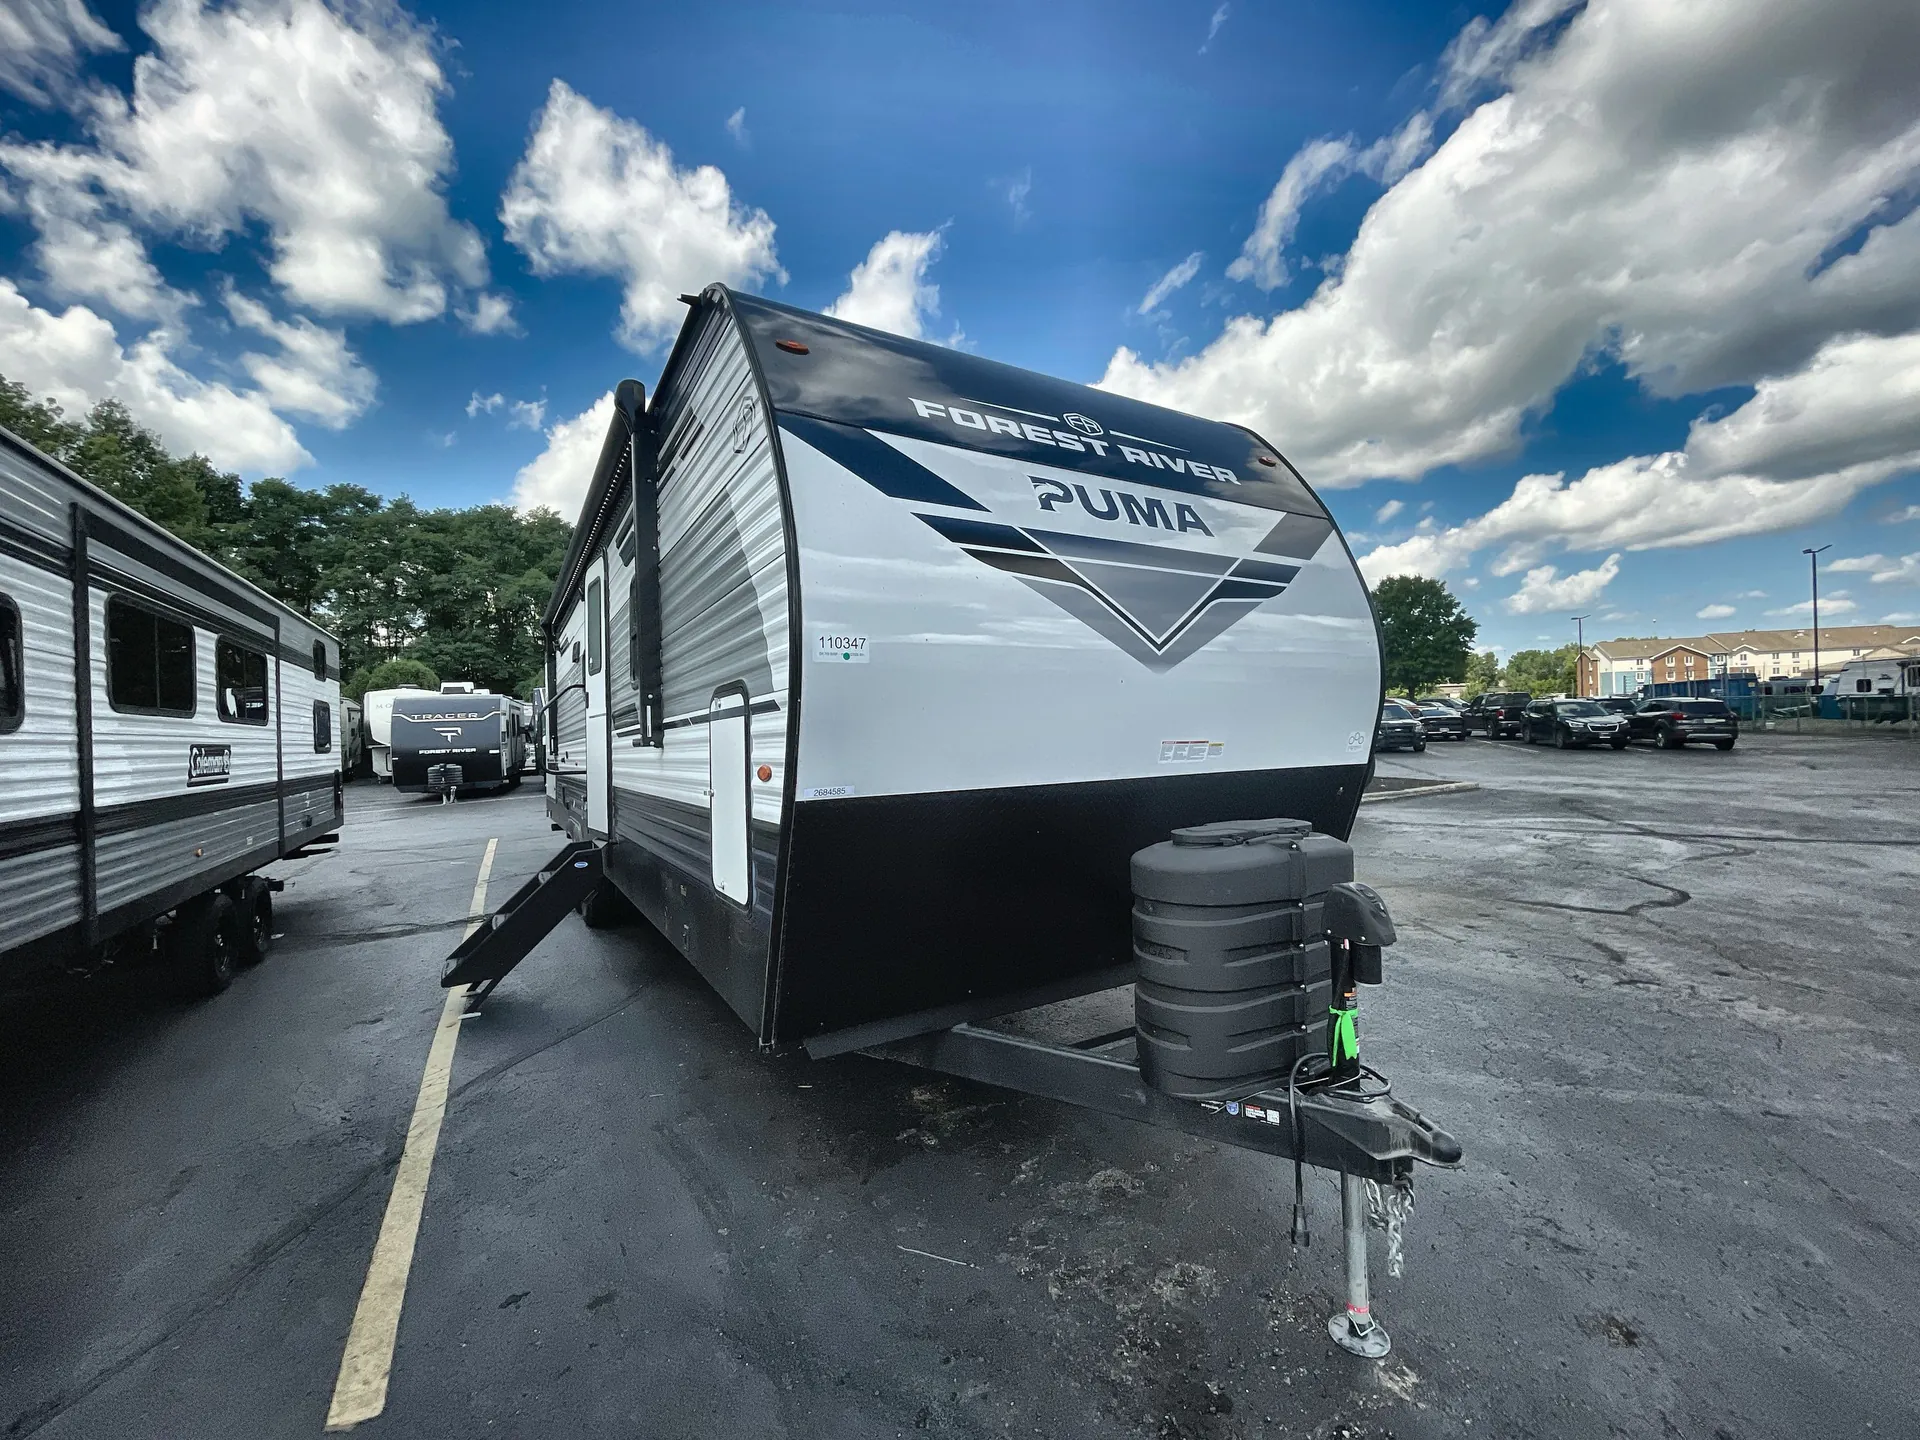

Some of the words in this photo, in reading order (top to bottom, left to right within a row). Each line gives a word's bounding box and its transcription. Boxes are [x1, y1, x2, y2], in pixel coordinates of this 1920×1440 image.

[908, 397, 1109, 457] FOREST
[1117, 444, 1242, 486] RIVER
[1027, 475, 1215, 537] PUMA
[819, 635, 866, 650] 110347
[411, 712, 479, 720] TRACER
[191, 747, 224, 777] Coleman
[813, 787, 846, 797] 2684585
